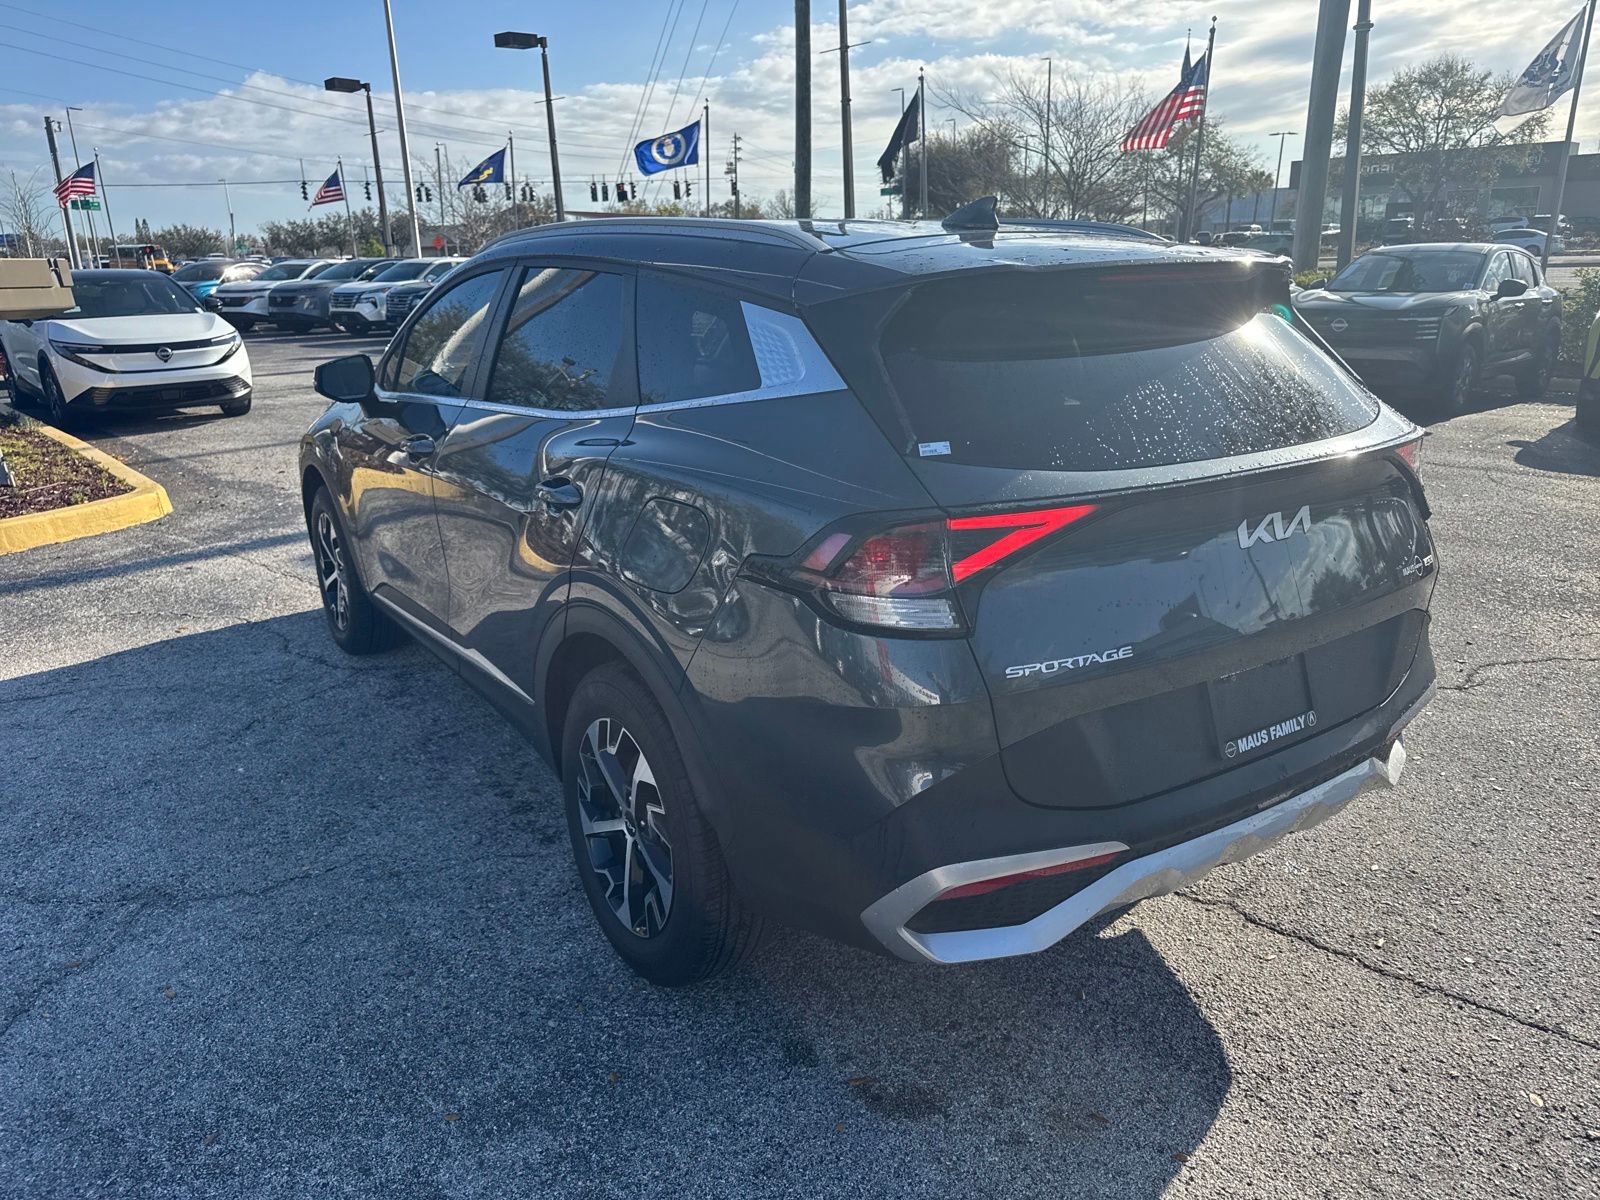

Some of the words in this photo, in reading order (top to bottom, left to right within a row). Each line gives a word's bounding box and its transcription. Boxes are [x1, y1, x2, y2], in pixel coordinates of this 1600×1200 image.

[1237, 504, 1311, 549] KIA
[1005, 646, 1133, 679] SPORTAGE
[1238, 730, 1268, 753] MAUS
[1269, 715, 1305, 740] FAMILY
